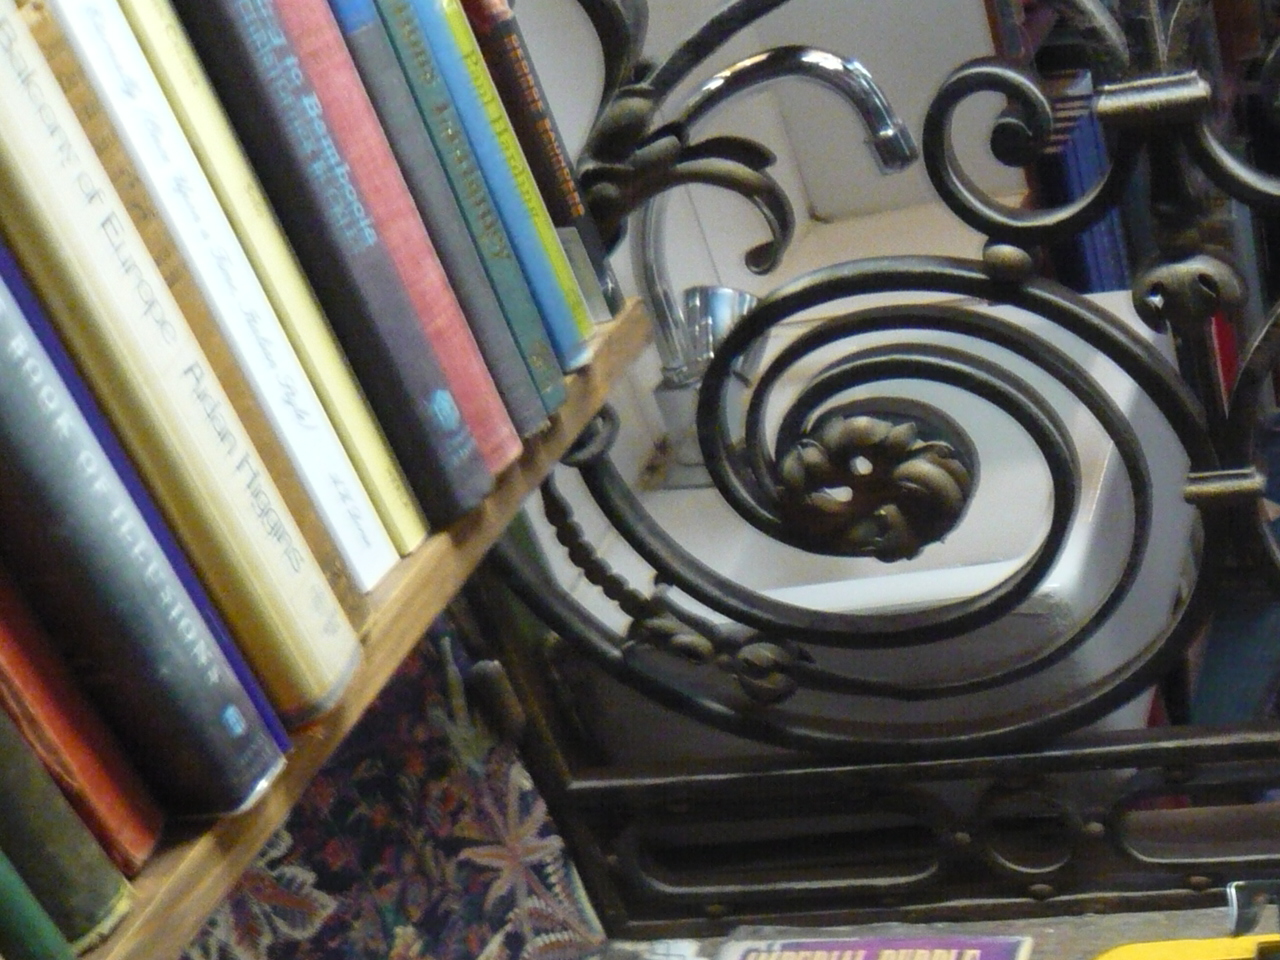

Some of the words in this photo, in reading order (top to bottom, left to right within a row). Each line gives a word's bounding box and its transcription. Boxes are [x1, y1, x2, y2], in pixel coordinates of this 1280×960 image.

[7, 333, 77, 441] BOOK
[76, 448, 109, 494] OF
[109, 504, 220, 686] ILLUSIONS
[76, 170, 107, 206] of
[100, 210, 178, 345] Europe
[183, 360, 238, 456] Aidan
[235, 452, 305, 574] Higgins
